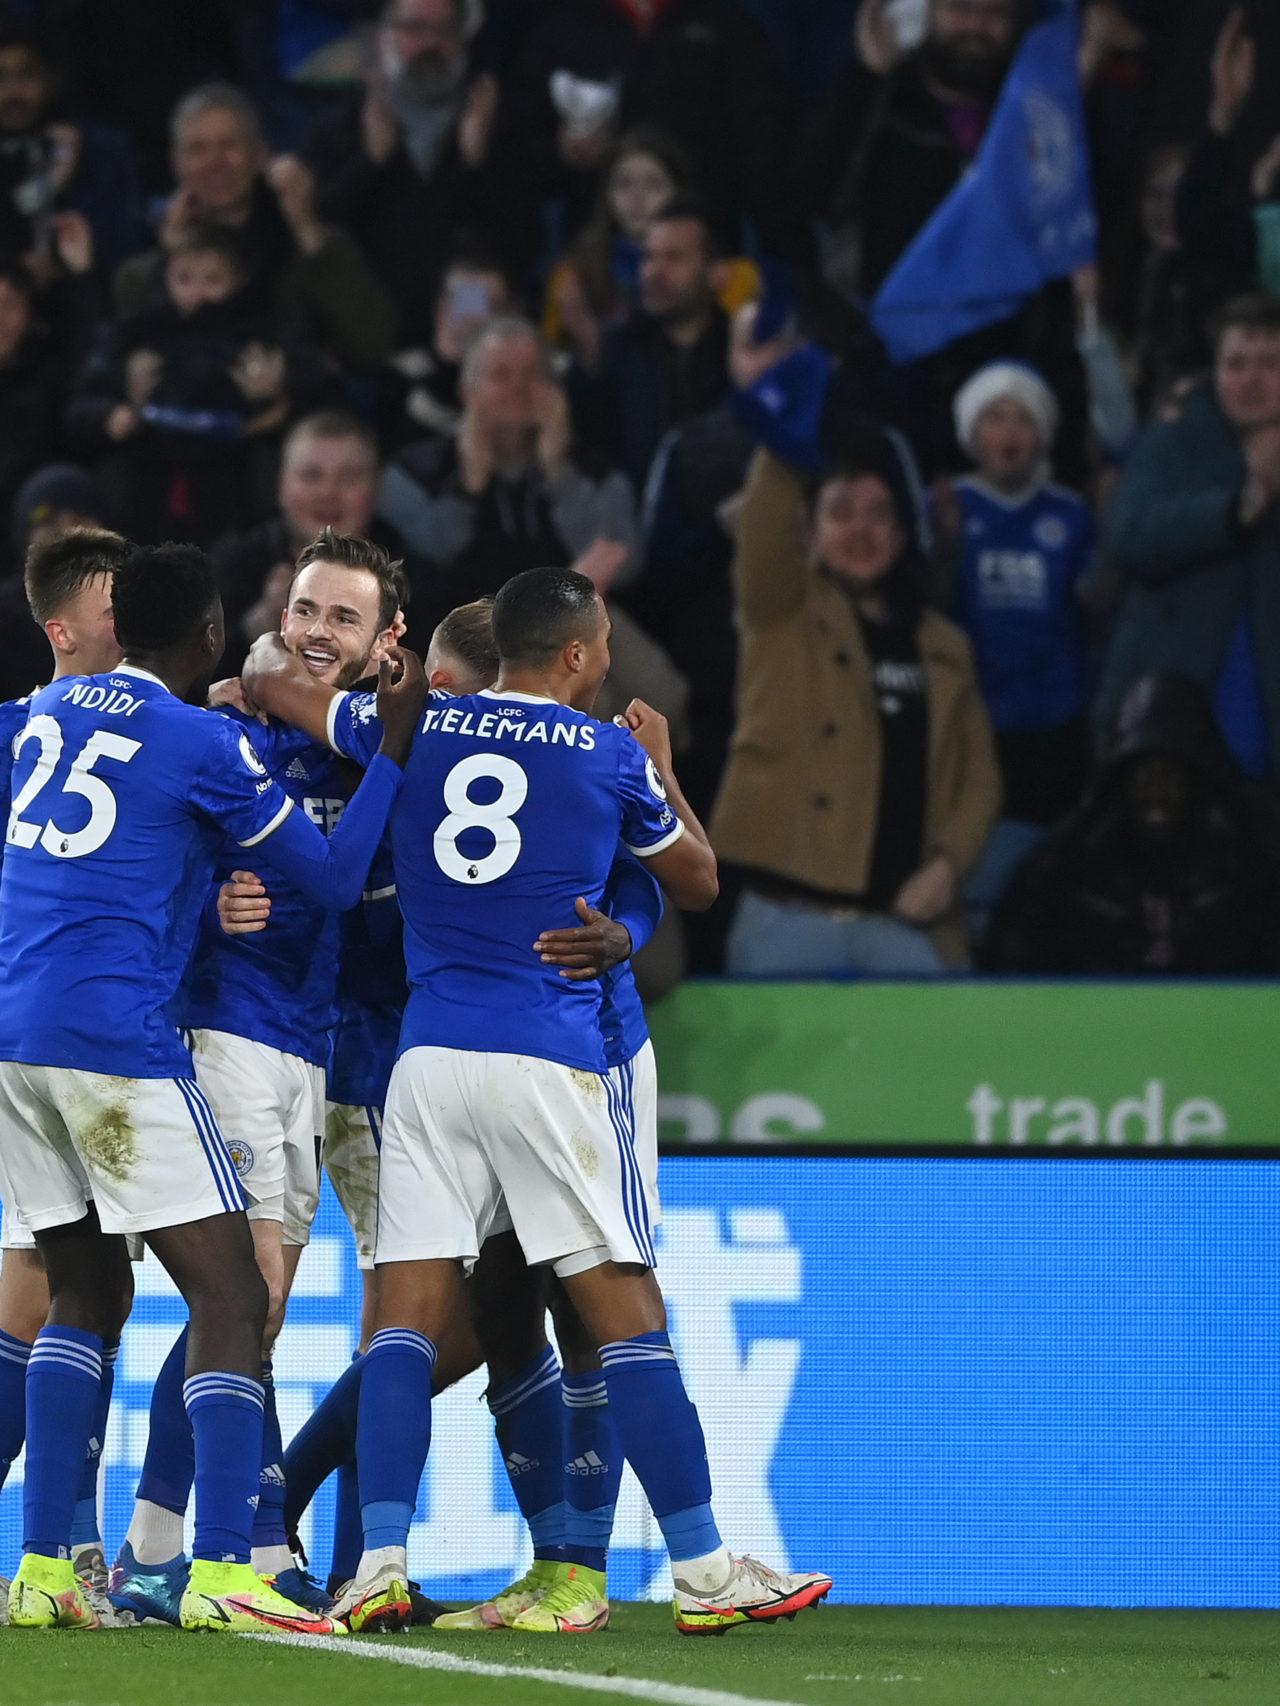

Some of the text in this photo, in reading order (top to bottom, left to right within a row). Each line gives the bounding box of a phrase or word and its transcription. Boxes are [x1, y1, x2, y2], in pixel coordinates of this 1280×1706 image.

[62, 684, 146, 717] NDIDI
[422, 707, 596, 751] TIELEMANS
[5, 713, 143, 859] 25
[433, 752, 528, 885] 8
[967, 1079, 1228, 1145] trade
